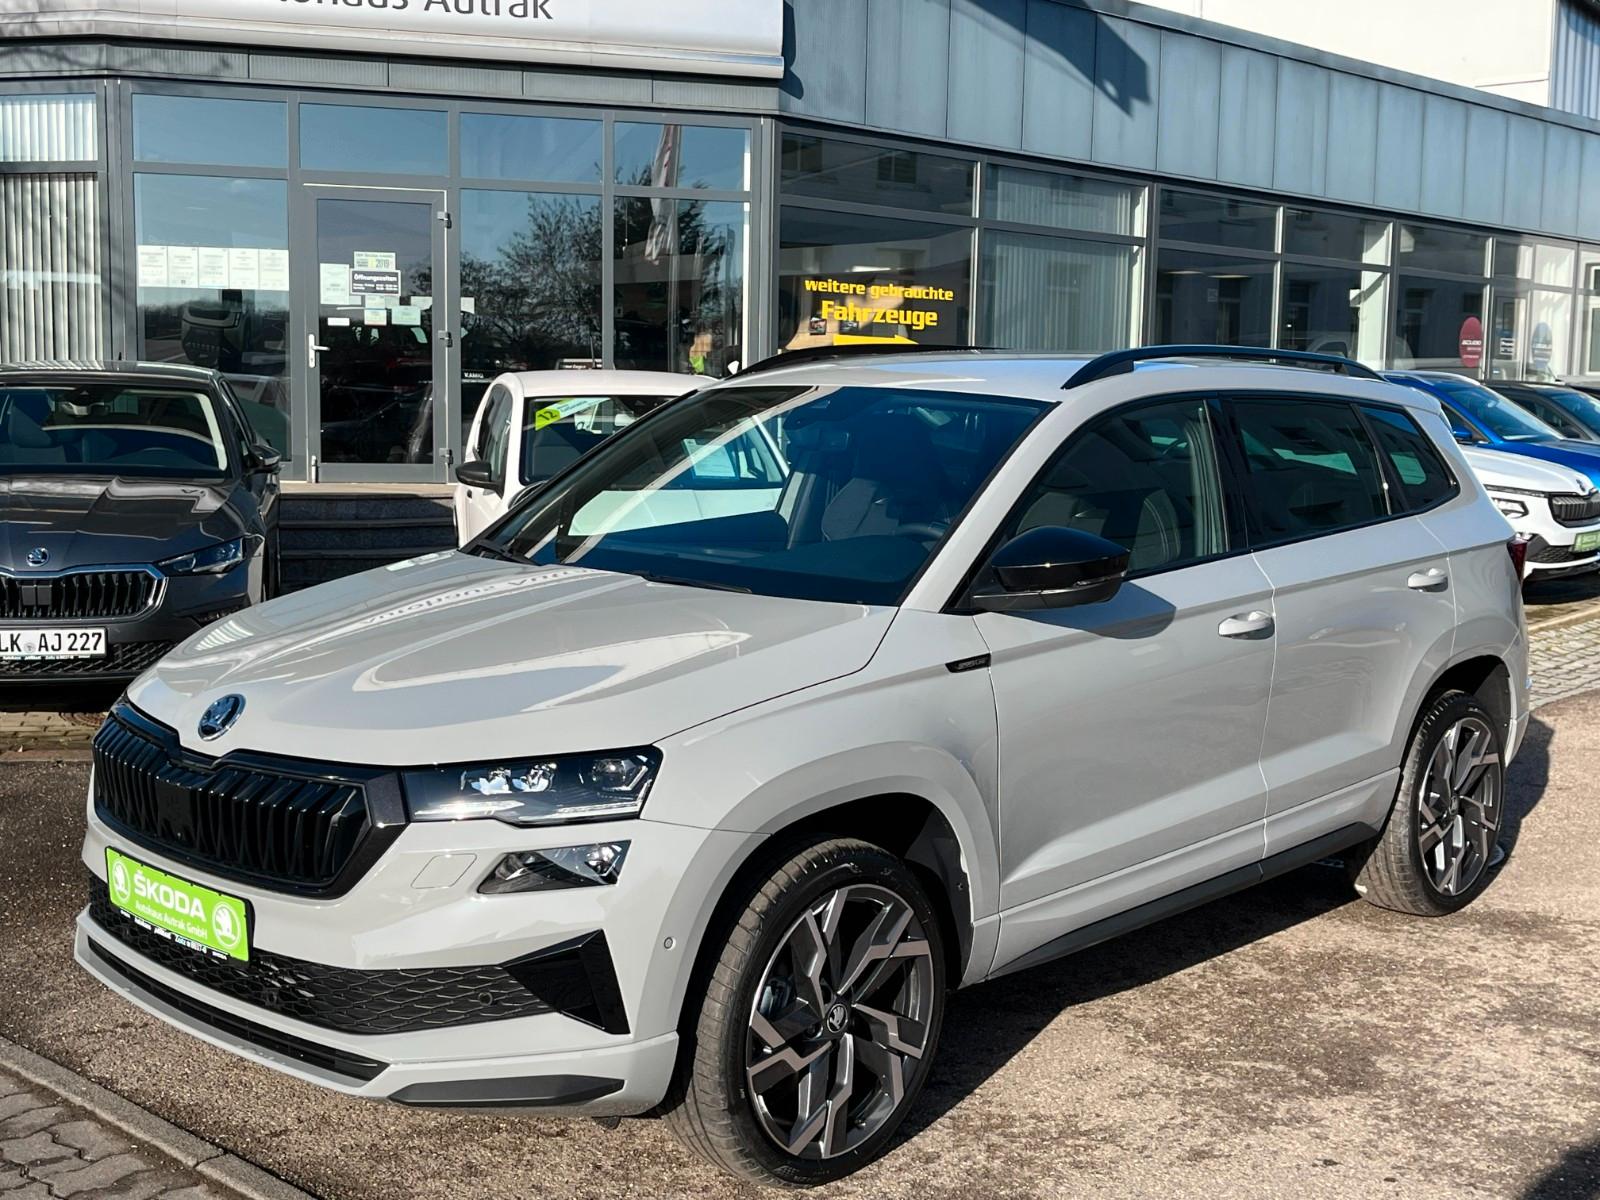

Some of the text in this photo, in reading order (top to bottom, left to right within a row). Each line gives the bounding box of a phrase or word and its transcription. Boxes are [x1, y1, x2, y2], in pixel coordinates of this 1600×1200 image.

[804, 278, 954, 301] weitere gebrauchte
[821, 300, 938, 330] Fahrzeuge
[38, 633, 62, 652] AJ
[67, 632, 102, 651] 227
[133, 869, 206, 922] ŠKODA
[135, 900, 163, 920] Autohaus
[187, 922, 208, 939] GmbH
